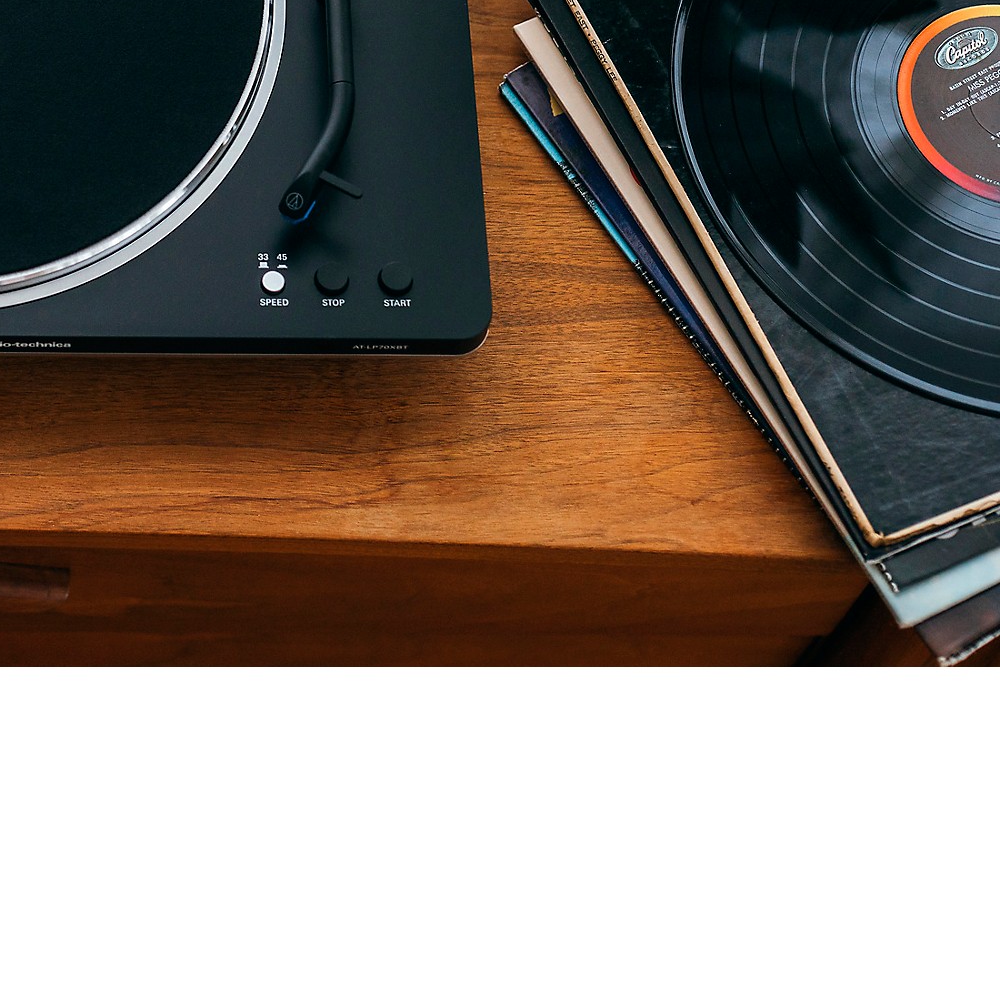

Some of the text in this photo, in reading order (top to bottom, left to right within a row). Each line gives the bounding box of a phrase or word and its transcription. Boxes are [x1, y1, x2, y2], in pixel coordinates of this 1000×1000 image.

[575, 10, 589, 31] EAST
[590, 39, 608, 65] PEGGY
[945, 30, 988, 64] Capitol
[967, 78, 986, 92] MISS
[257, 253, 288, 261] 33 45
[259, 298, 289, 307] SPEED
[321, 298, 346, 307] STOP
[383, 299, 412, 308] START
